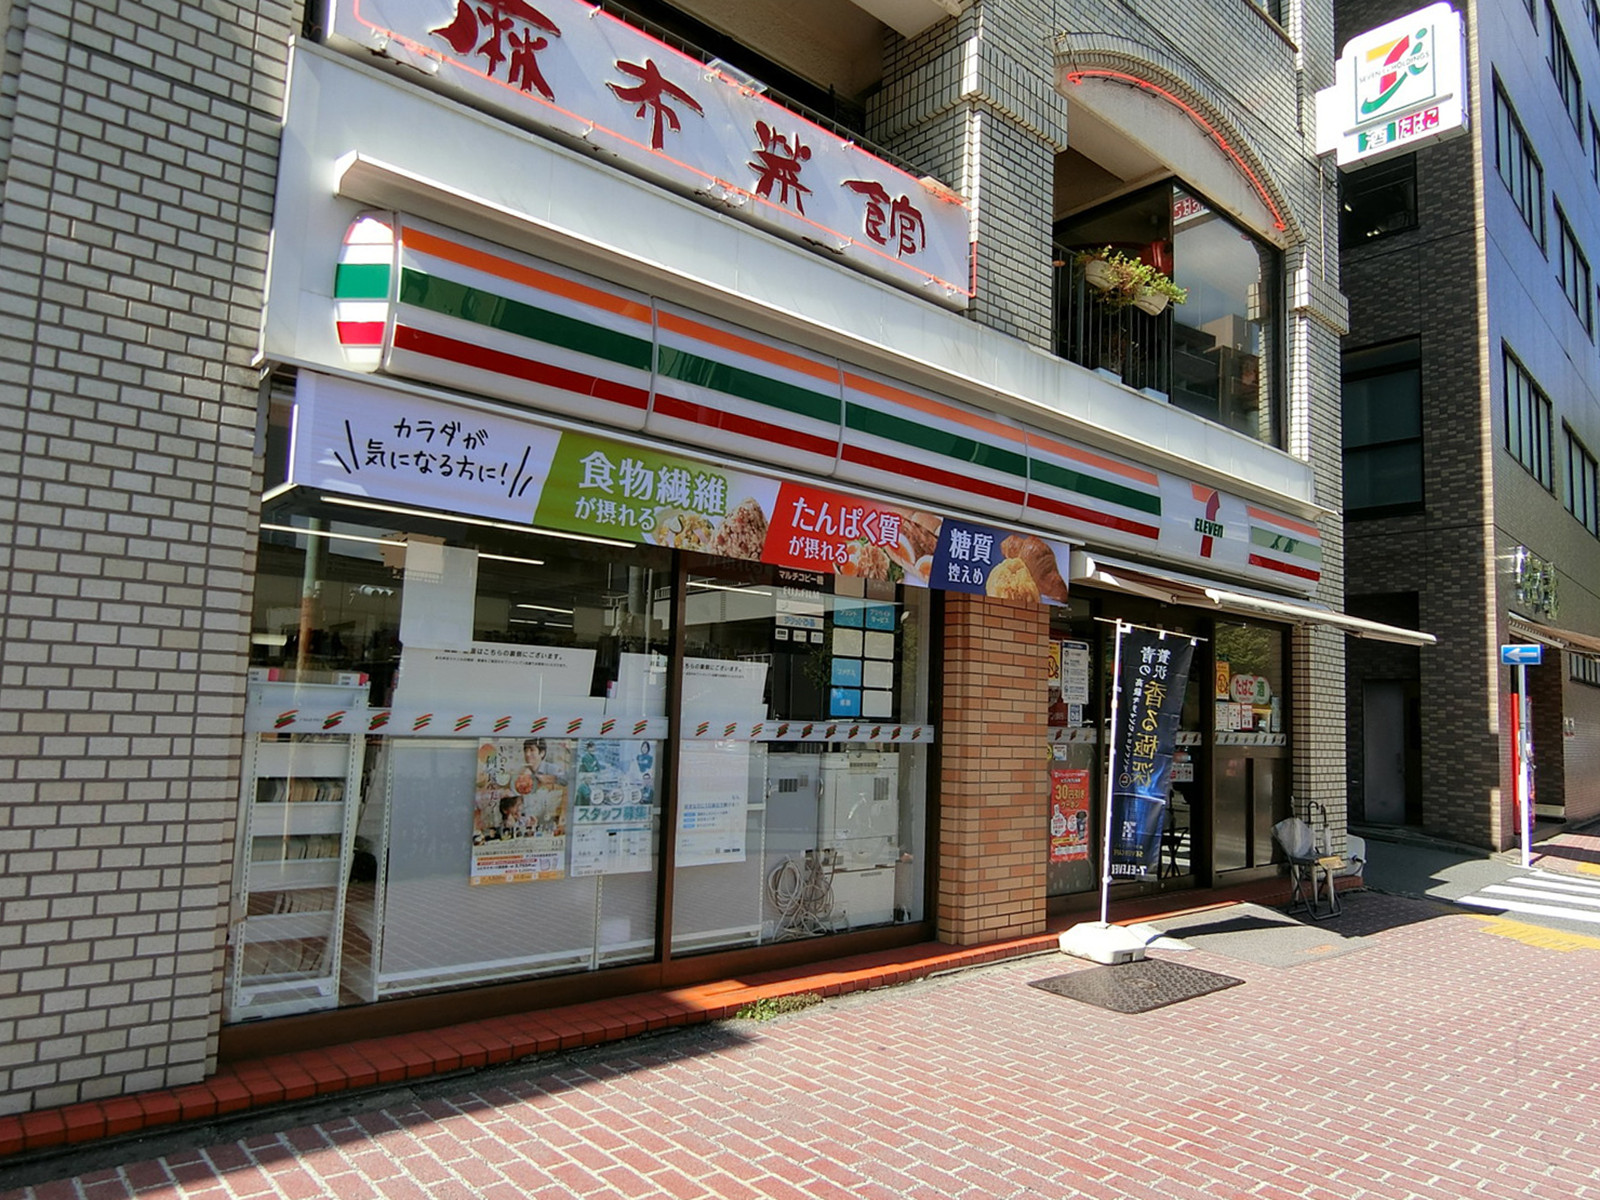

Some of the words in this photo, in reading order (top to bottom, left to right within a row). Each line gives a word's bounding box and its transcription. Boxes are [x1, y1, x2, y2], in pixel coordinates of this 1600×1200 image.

[1364, 128, 1388, 150] 酒
[1400, 110, 1438, 138] たばこ
[392, 416, 489, 450] カラダが
[578, 450, 728, 516] 食物繊維
[574, 495, 657, 532] が摂れる
[791, 496, 901, 549] たんぱく質
[788, 535, 849, 566] が摂れる
[948, 527, 995, 566] 糖質
[947, 563, 984, 587] 控えめ
[1235, 678, 1254, 696] たばこ
